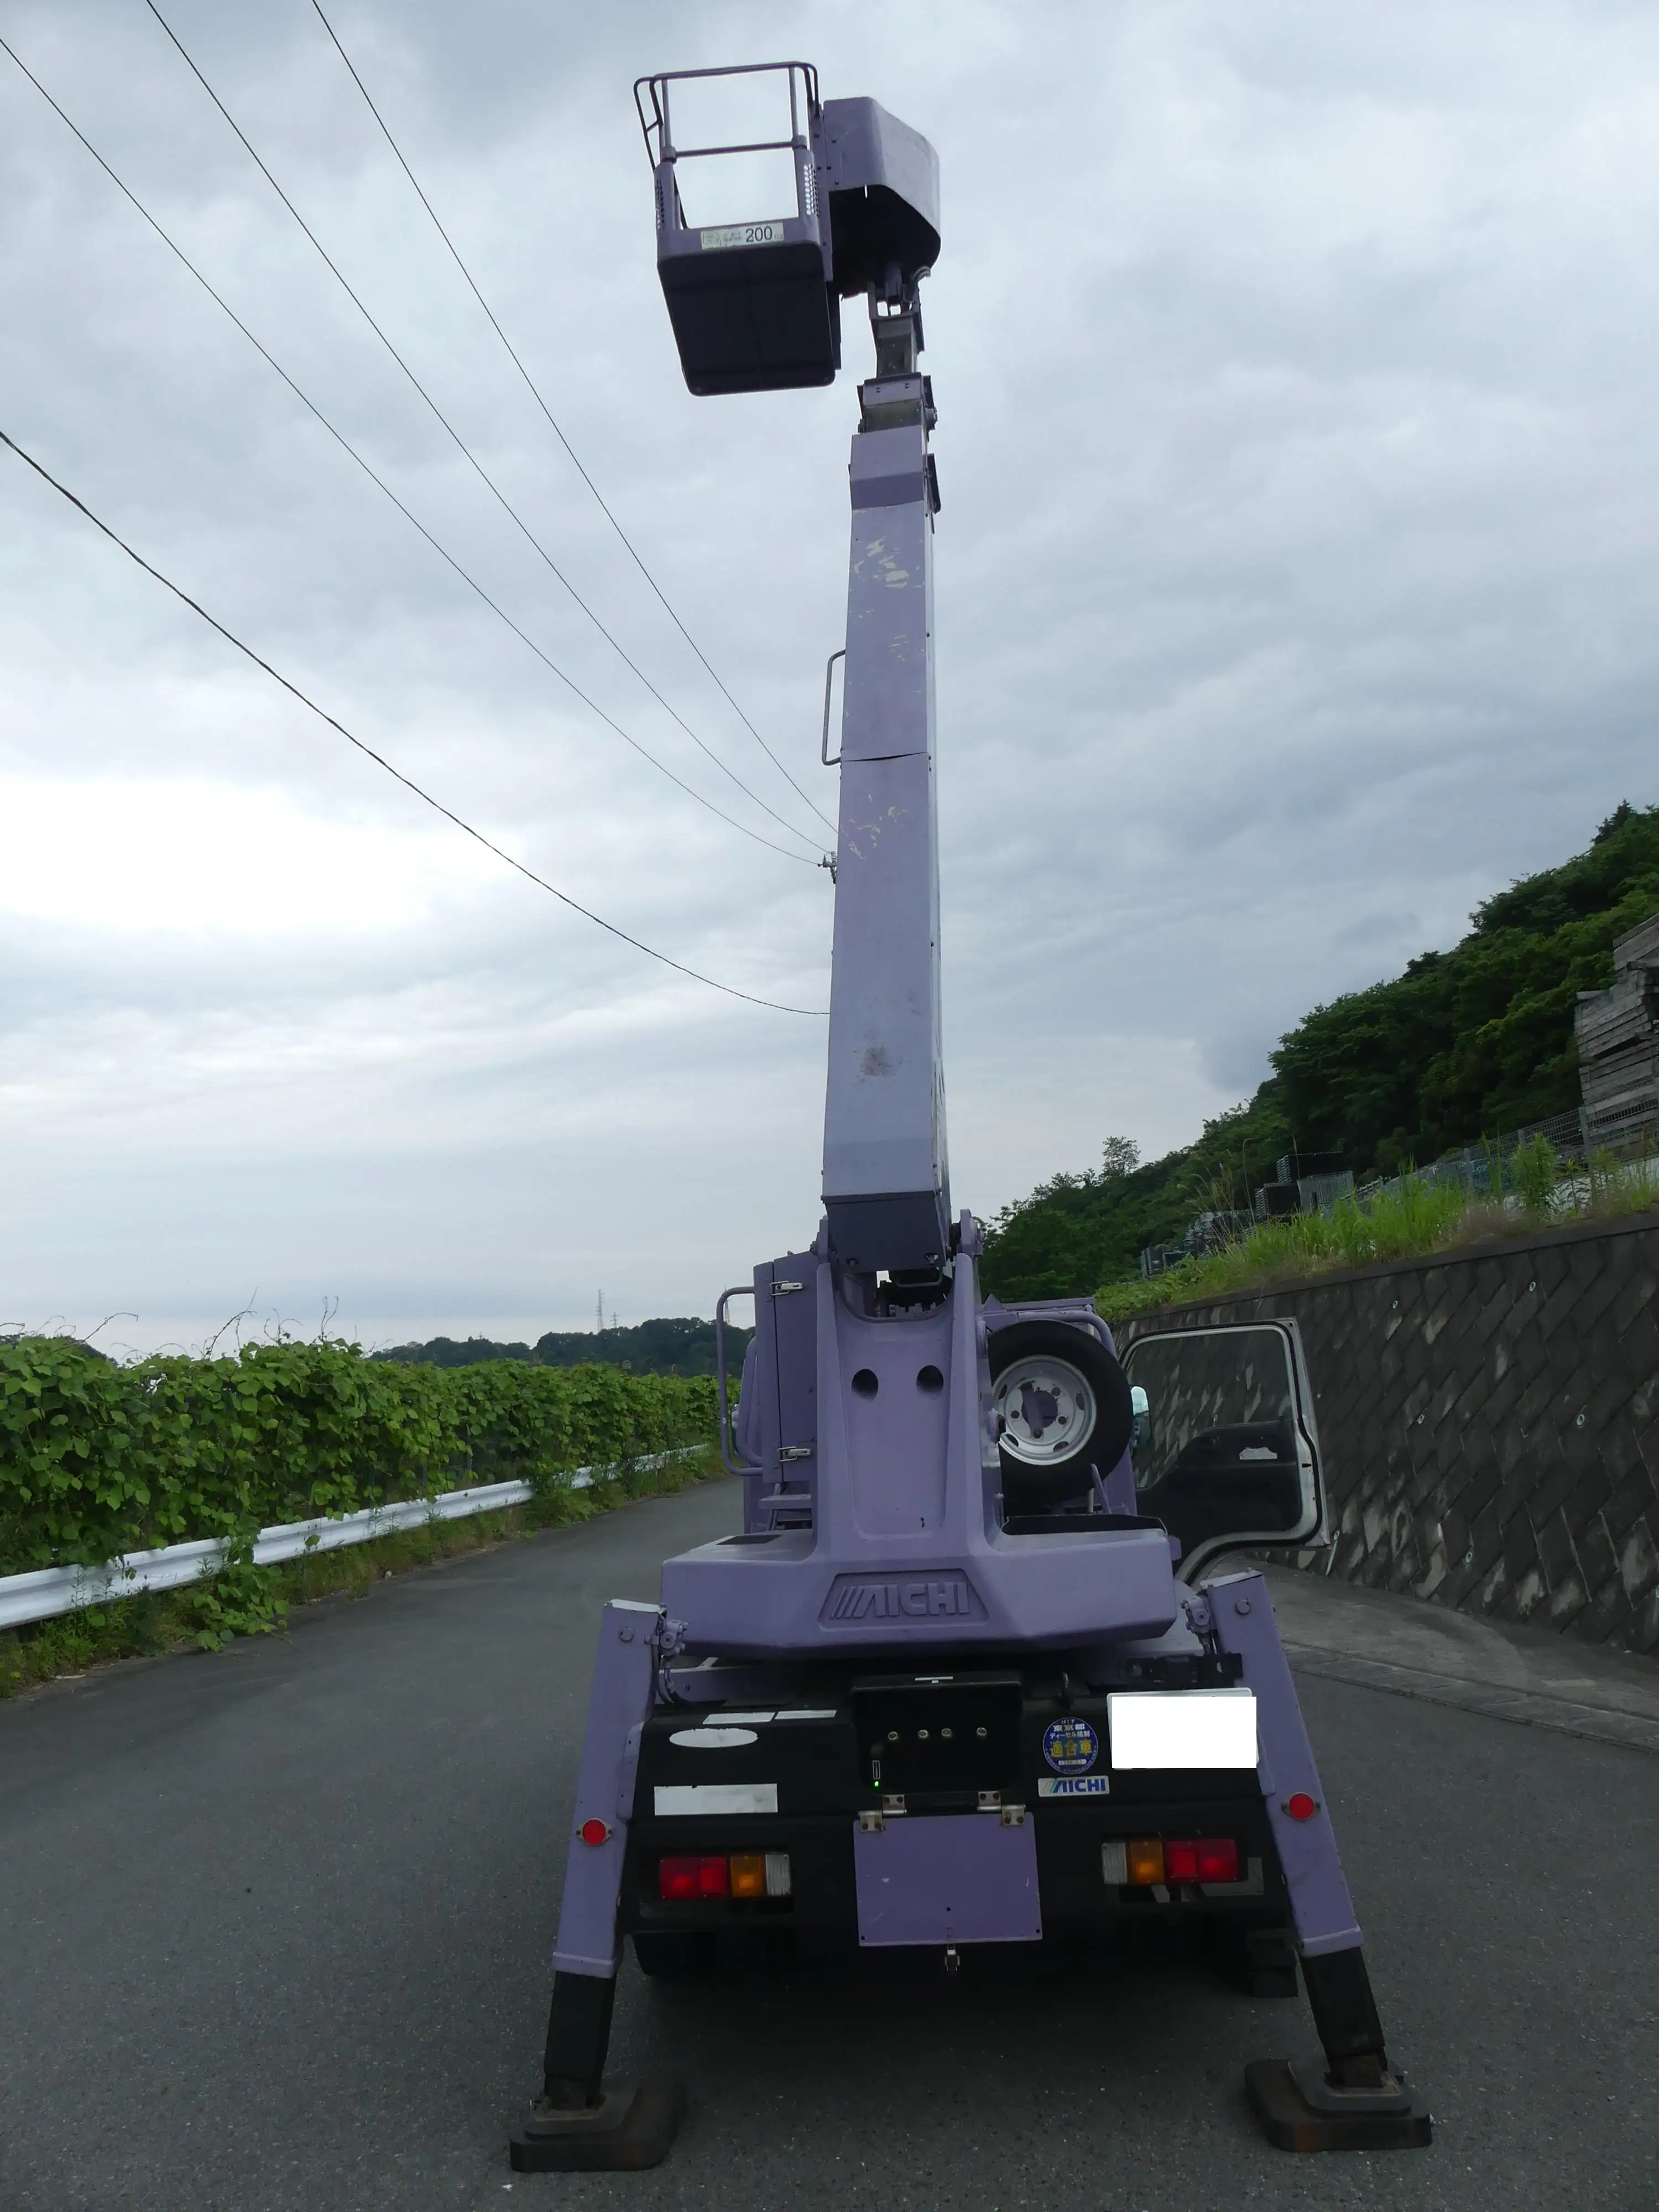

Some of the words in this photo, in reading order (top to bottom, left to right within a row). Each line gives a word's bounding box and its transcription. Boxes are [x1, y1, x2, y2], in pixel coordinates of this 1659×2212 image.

[745, 226, 773, 243] 200
[849, 1581, 969, 1618] AICHI
[1049, 1730, 1091, 1739] ディーゼル規制
[1053, 1723, 1085, 1732] 東京都
[1050, 1739, 1093, 1758] 適合車
[1053, 1778, 1105, 1793] AICHI
